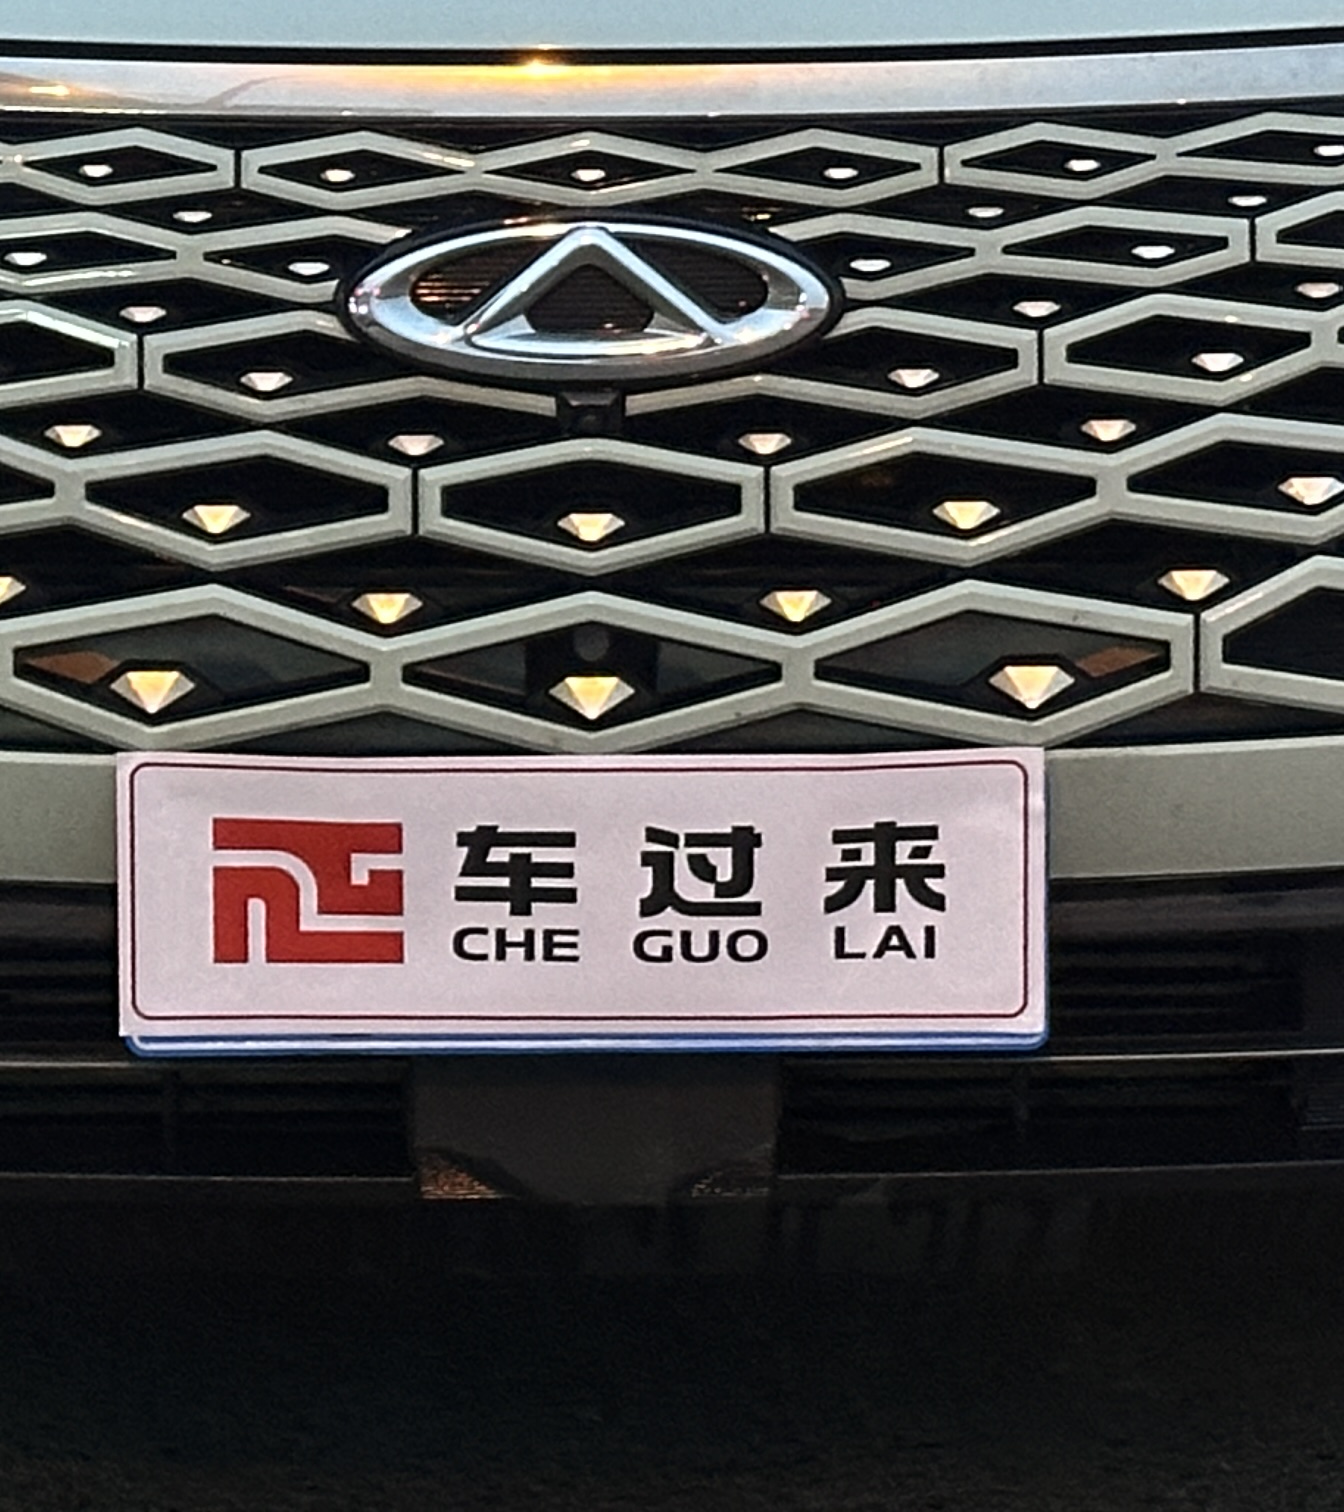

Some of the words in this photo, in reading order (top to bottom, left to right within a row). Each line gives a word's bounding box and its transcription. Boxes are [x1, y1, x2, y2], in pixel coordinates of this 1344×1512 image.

[454, 820, 946, 918] 车过来
[452, 926, 580, 963] CHE
[632, 928, 769, 964] GUO
[833, 924, 937, 960] LAI
